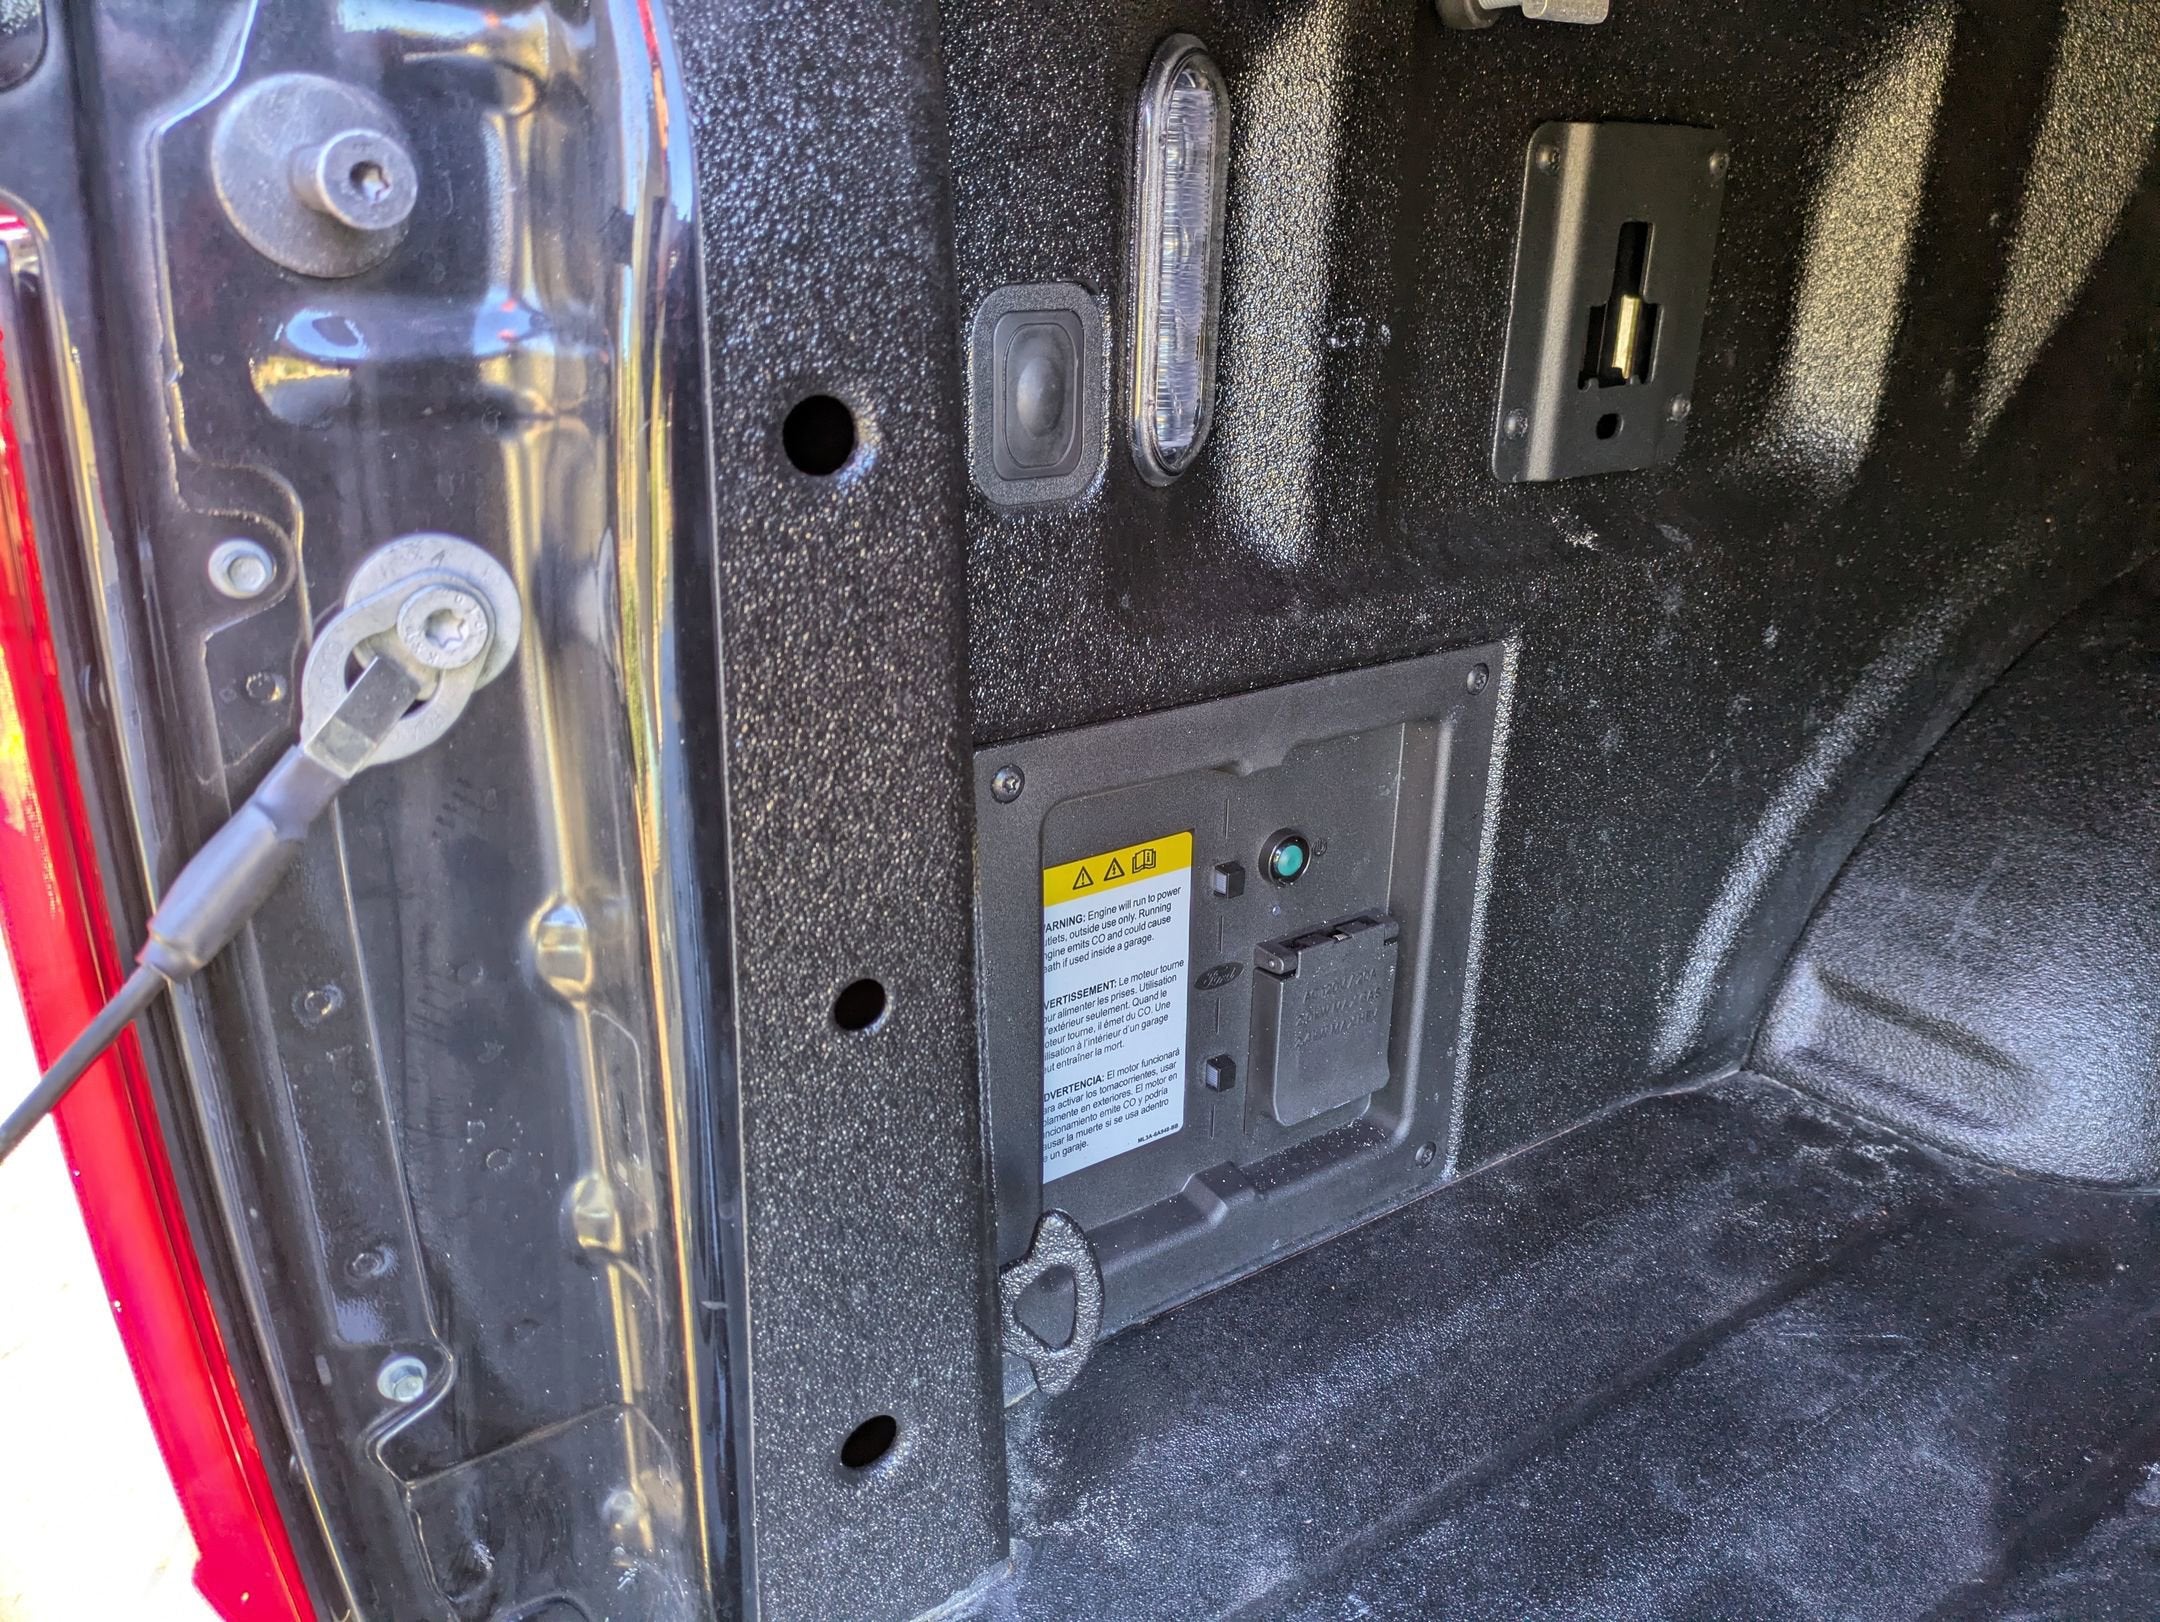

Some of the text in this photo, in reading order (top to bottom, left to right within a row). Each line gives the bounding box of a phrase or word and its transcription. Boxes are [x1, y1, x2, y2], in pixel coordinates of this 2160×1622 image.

[1044, 886, 1181, 932] ARNING: Engine will run to power
[1069, 922, 1100, 940] outside
[1101, 918, 1116, 932] use
[1117, 910, 1137, 927] only.
[1138, 900, 1172, 919] Running
[1062, 957, 1068, 968] if
[1068, 950, 1089, 966] used
[1090, 944, 1115, 959] inside
[1116, 942, 1122, 951] a
[1123, 934, 1154, 951] garage.
[1067, 939, 1090, 953] emits
[1091, 933, 1106, 945] CO
[1106, 927, 1122, 941] and
[1124, 920, 1146, 937] could
[1147, 915, 1171, 928] cause
[1044, 959, 1184, 1010] VERTISSEMENT: Le moteur tourne
[1057, 999, 1096, 1019] alimenter
[1096, 996, 1109, 1006] les
[1110, 987, 1137, 1004] prises.
[1139, 974, 1177, 992] Utilisation
[1067, 1026, 1096, 1040] tourne,
[1097, 1021, 1102, 1031] il
[1103, 1014, 1124, 1028] émet
[1125, 1011, 1136, 1022] du
[1137, 1005, 1153, 1017] CO.
[1154, 1000, 1171, 1012] Une
[1085, 1000, 1130, 1022] seulement.
[1131, 990, 1159, 1007] Quand
[1160, 989, 1167, 998] le
[1076, 1040, 1082, 1050] à
[1083, 1028, 1121, 1048] l'intérieur
[1122, 1023, 1140, 1035] d'un
[1140, 1013, 1168, 1031] garage
[1056, 1050, 1093, 1069] entraîner
[1094, 1047, 1102, 1056] la
[1103, 1039, 1124, 1053] mort.
[1043, 1047, 1180, 1102] DVERTENCIA: El motor funcionará
[1057, 1093, 1083, 1110] activar
[1085, 1089, 1097, 1100] los
[1099, 1068, 1158, 1094] tomacorrientes,
[1160, 1061, 1176, 1073] usar
[1080, 1103, 1090, 1113] en
[1092, 1089, 1133, 1109] exteriores.
[1135, 1082, 1143, 1093] El
[1144, 1076, 1167, 1090] motor
[1168, 1072, 1177, 1081] en
[1066, 1133, 1073, 1142] la
[1075, 1122, 1103, 1139] muerte
[1105, 1117, 1112, 1127] si
[1113, 1115, 1123, 1124] se
[1124, 1109, 1139, 1120] usa
[1140, 1097, 1169, 1114] adentro
[1099, 1104, 1121, 1118] emite
[1122, 1097, 1136, 1109] CO
[1137, 1096, 1142, 1106] y
[1144, 1086, 1168, 1104] podría
[1049, 1150, 1060, 1160] un
[1062, 1140, 1089, 1157] garaje.
